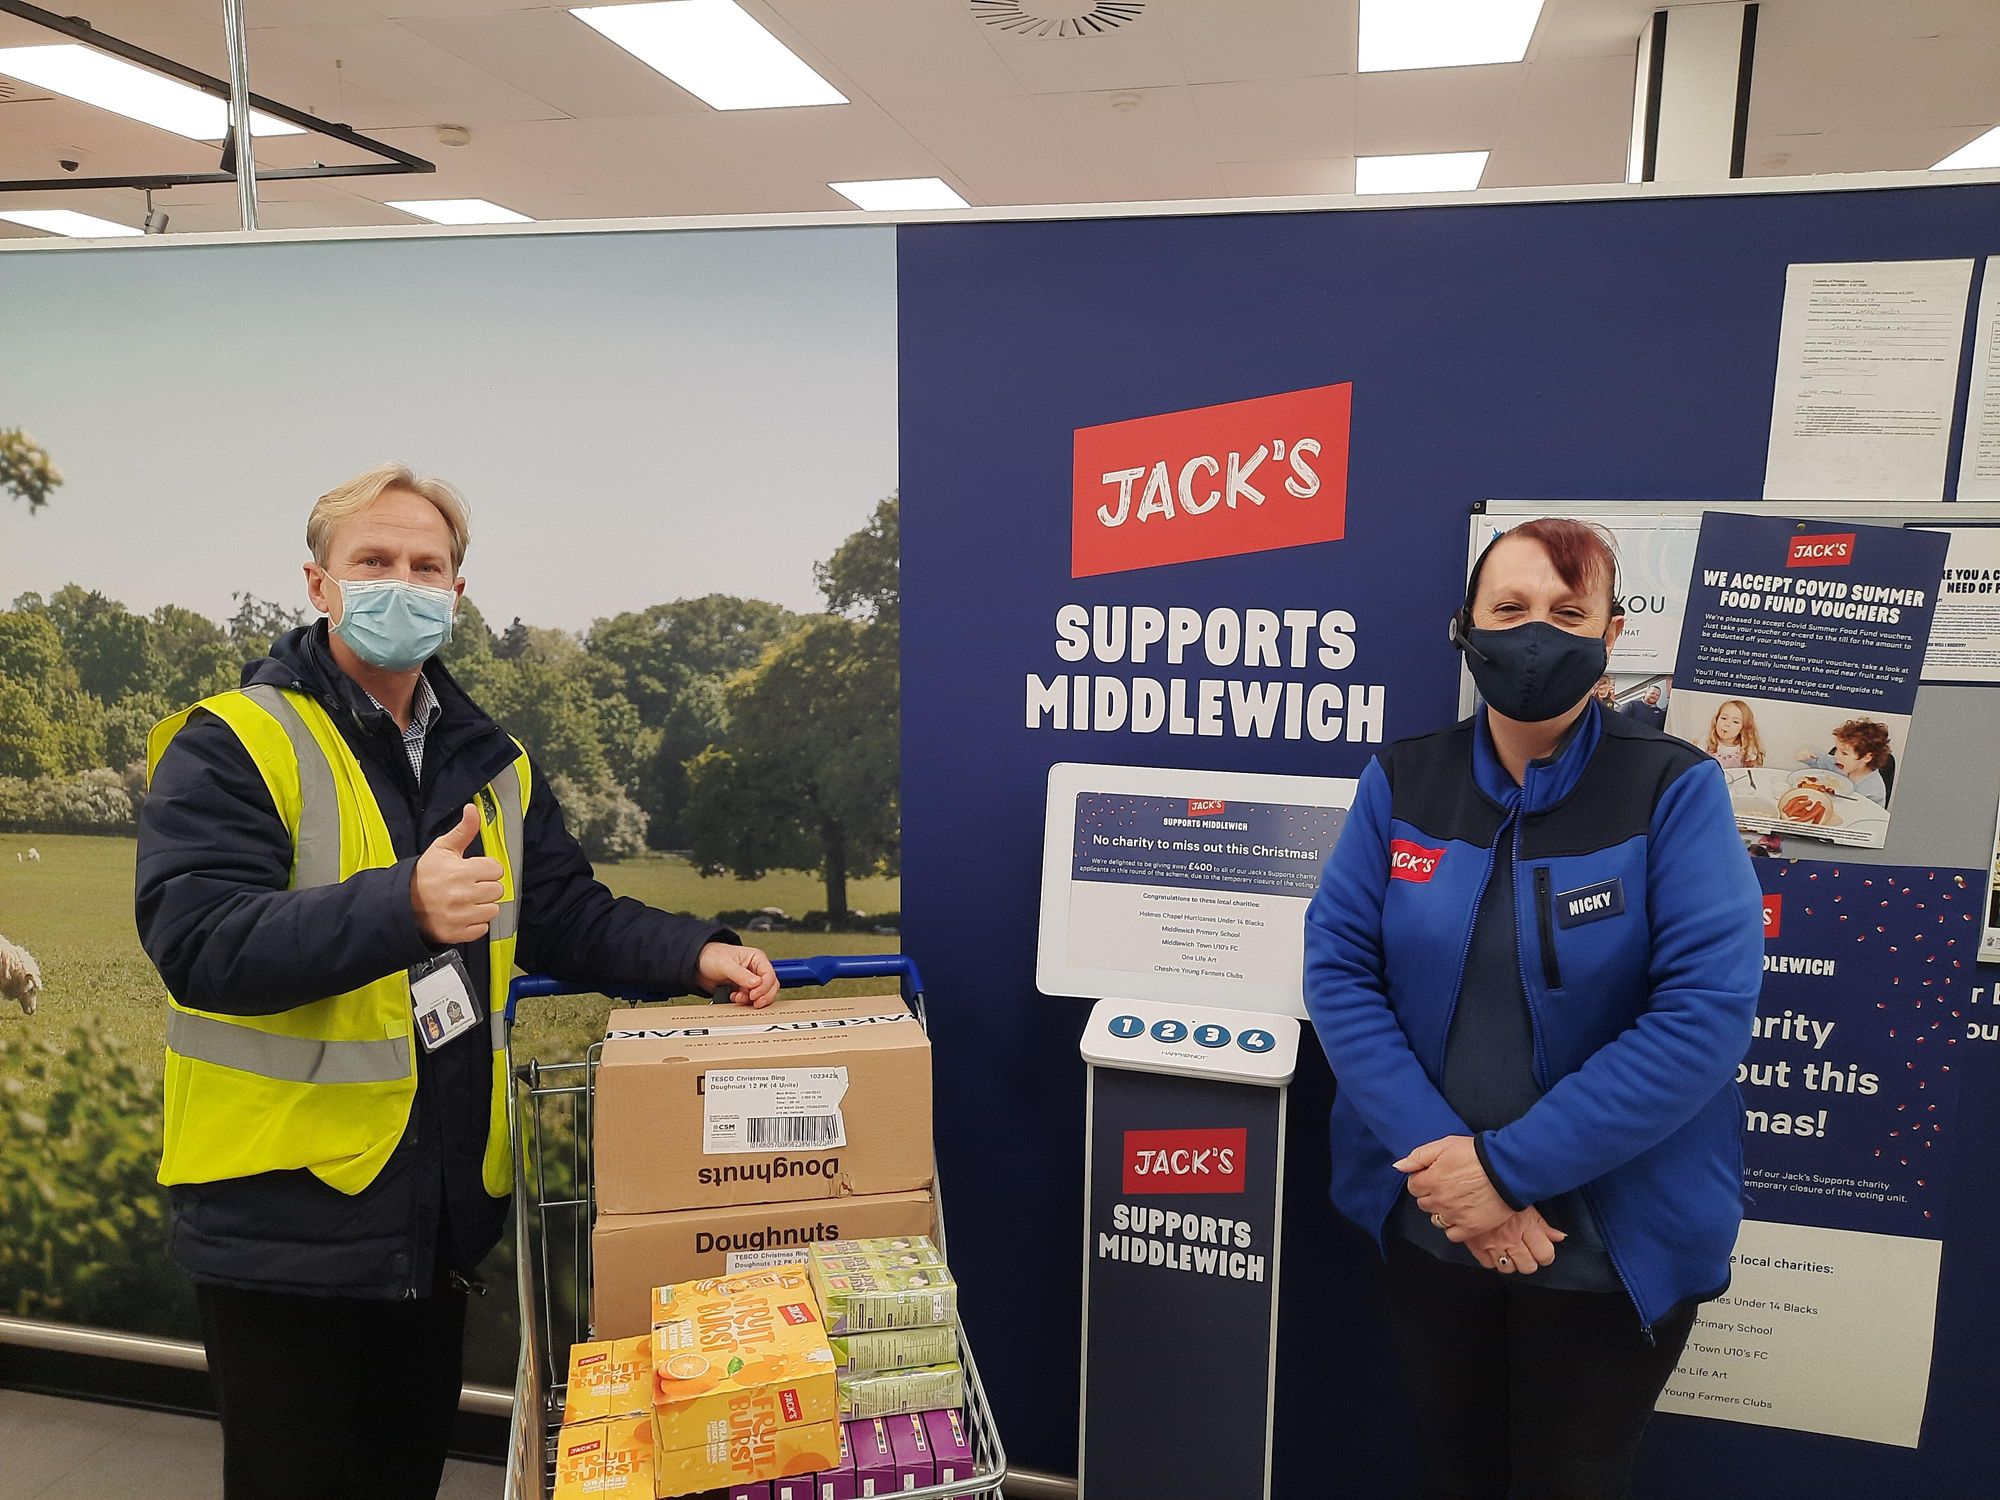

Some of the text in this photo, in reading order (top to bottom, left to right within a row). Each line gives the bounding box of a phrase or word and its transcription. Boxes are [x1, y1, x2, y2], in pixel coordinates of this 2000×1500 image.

[1097, 437, 1321, 527] JACK'S
[1794, 543, 1848, 558] JACK'S
[1956, 570, 1979, 580] YOU
[1982, 570, 1990, 580] A
[1704, 570, 1925, 608] WE ACCEPT COVID SUMMER
[1947, 583, 1976, 594] NEED
[1978, 583, 1993, 594] OF
[1720, 590, 1900, 624] FOOD FUND VOUCHERS
[1055, 604, 1356, 669] SUPPORTS
[1703, 622, 1719, 630] Just
[1720, 624, 1736, 632] take
[1737, 626, 1752, 634] your
[1754, 627, 1781, 636] voucher
[1825, 634, 1838, 642] the
[1838, 635, 1849, 643] till
[1850, 636, 1860, 644] for
[1862, 638, 1874, 646] the
[1876, 641, 1902, 649] amount
[1904, 642, 1912, 650] to
[1705, 612, 1724, 621] We're
[1726, 615, 1752, 624] pleased
[1762, 620, 1785, 628] accept
[1786, 621, 1807, 630] Covid
[1808, 624, 1838, 633] Summer
[1840, 626, 1858, 635] Food
[1860, 629, 1878, 637] Fund
[1879, 632, 1913, 641] vouchers.
[1702, 630, 1807, 648] be deducted off your shopping.
[1025, 673, 1385, 743] MIDDLEWICH
[1192, 800, 1222, 811] JACK'S
[1163, 818, 1248, 831] SUPPORTS MIDDLEWICH
[1093, 834, 1319, 860] No charity to miss out this Christmas!
[1188, 862, 1212, 872] £400
[1142, 893, 1190, 902] Congratulations
[1568, 892, 1612, 917] NICKY
[1162, 926, 1240, 938] Middlewich Primary School
[1162, 940, 1195, 948] Middlewich
[1196, 942, 1212, 950] Town
[1181, 968, 1200, 976] Young
[1200, 970, 1226, 978] Farmers
[1763, 955, 1836, 976] DLEWICH
[764, 1012, 914, 1032] AKERY
[1122, 1018, 1264, 1048] 1 2 3 4
[770, 1082, 778, 1090] (4
[1803, 1062, 1880, 1096] this
[698, 1156, 839, 1186] Doughnuts
[1134, 1147, 1235, 1176] JACK'S
[1752, 1169, 1762, 1177] of
[1782, 1172, 1811, 1182] Jack's
[1812, 1174, 1855, 1188] Supports
[1857, 1179, 1890, 1191] charity
[1790, 1184, 1824, 1194] closure
[1826, 1187, 1836, 1196] of
[1837, 1188, 1852, 1197] the
[1854, 1190, 1884, 1202] voting
[1886, 1194, 1908, 1204] unit.
[1113, 1204, 1252, 1248] SUPPORTS
[696, 1222, 839, 1254] Doughnuts
[760, 1251, 794, 1259] Christmas
[1098, 1232, 1265, 1283] MIDDLEWICH
[1740, 1254, 1771, 1268] local
[1774, 1258, 1835, 1275] charities:
[1734, 1297, 1766, 1310] Under
[1770, 1301, 1780, 1311] 14
[1783, 1303, 1818, 1315] Blacks
[696, 1300, 739, 1353] BURST
[735, 1297, 776, 1344] FRUIT
[1694, 1318, 1773, 1336] Primary School
[1693, 1342, 1721, 1354] Town
[1724, 1346, 1751, 1358] U10's
[1754, 1350, 1769, 1360] FC
[580, 1361, 641, 1377] FRUIT
[1689, 1368, 1709, 1377] Life
[1711, 1370, 1728, 1380] Art
[784, 1392, 798, 1420] JACK'S
[1664, 1388, 1772, 1409] Young Farmers Clubs
[728, 1394, 754, 1475] BURST
[752, 1396, 777, 1466] FRUIT
[570, 1443, 599, 1454] JACK'S
[570, 1449, 641, 1470] FRUIT
[563, 1460, 641, 1484] BURST
